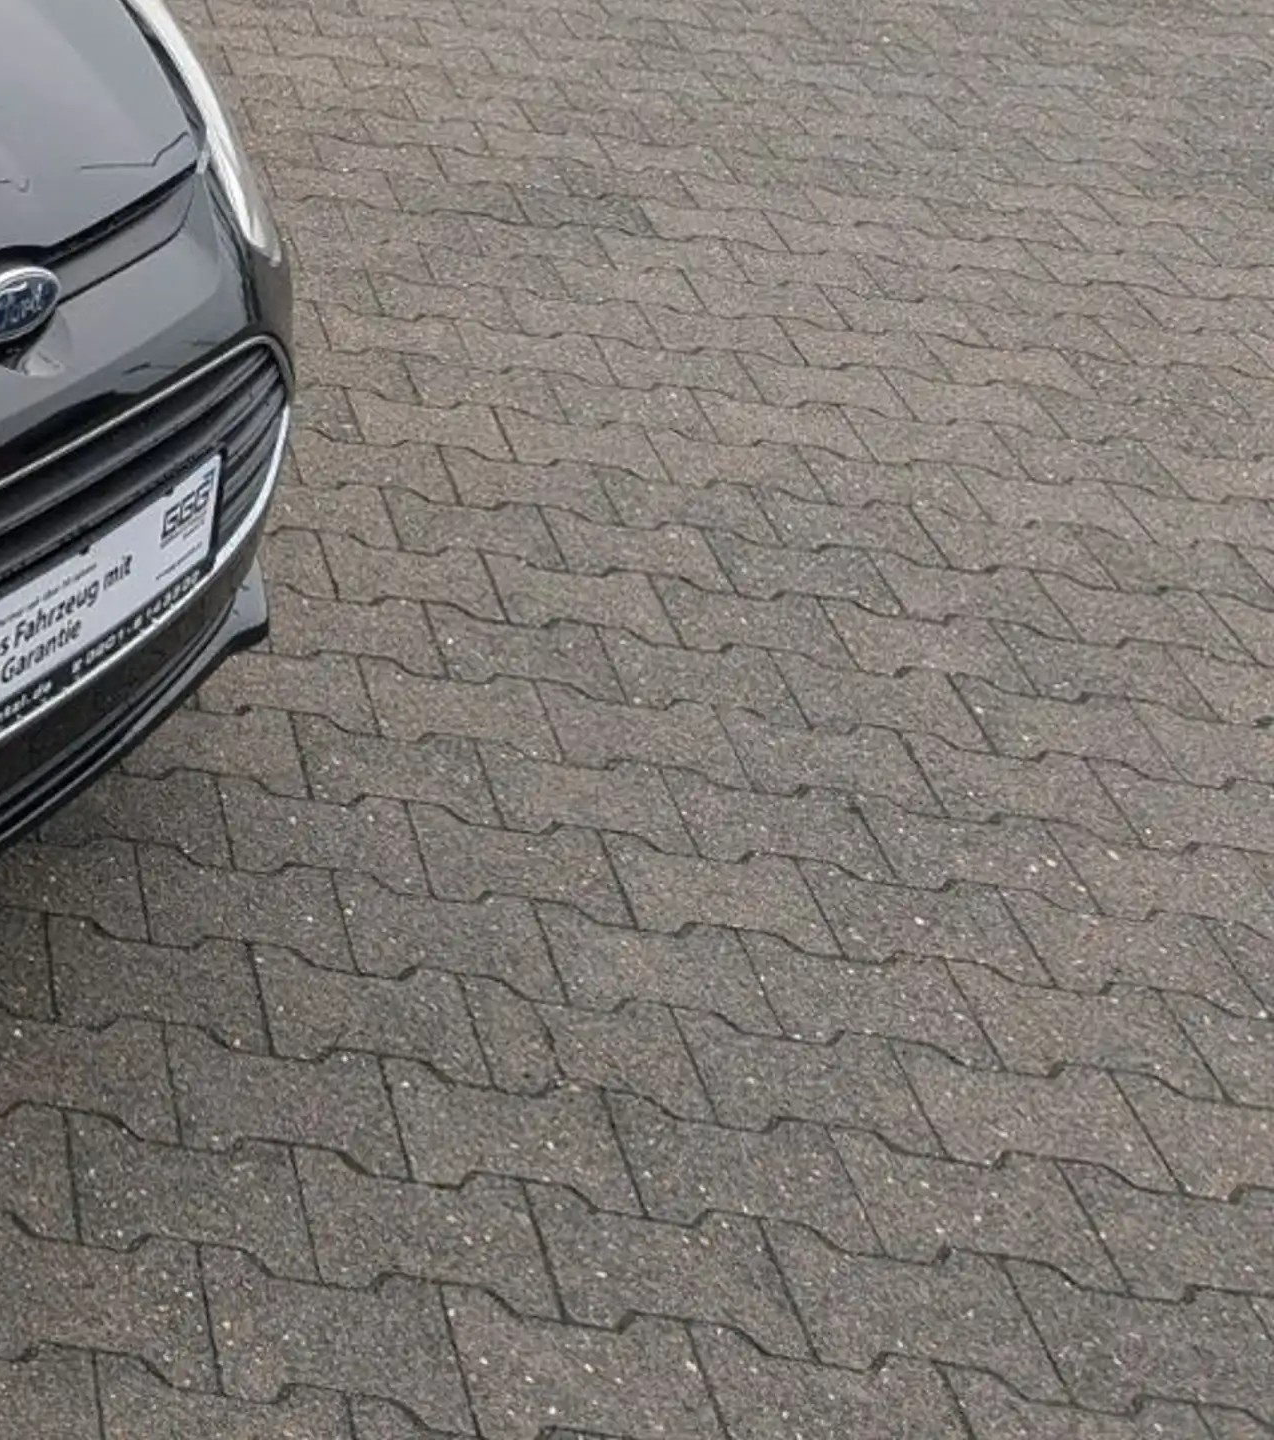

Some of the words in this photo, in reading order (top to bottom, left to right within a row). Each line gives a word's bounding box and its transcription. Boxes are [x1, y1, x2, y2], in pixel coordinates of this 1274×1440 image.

[12, 578, 101, 649] Fahrzeug
[103, 554, 133, 591] mit
[1, 618, 82, 684] Garantie
